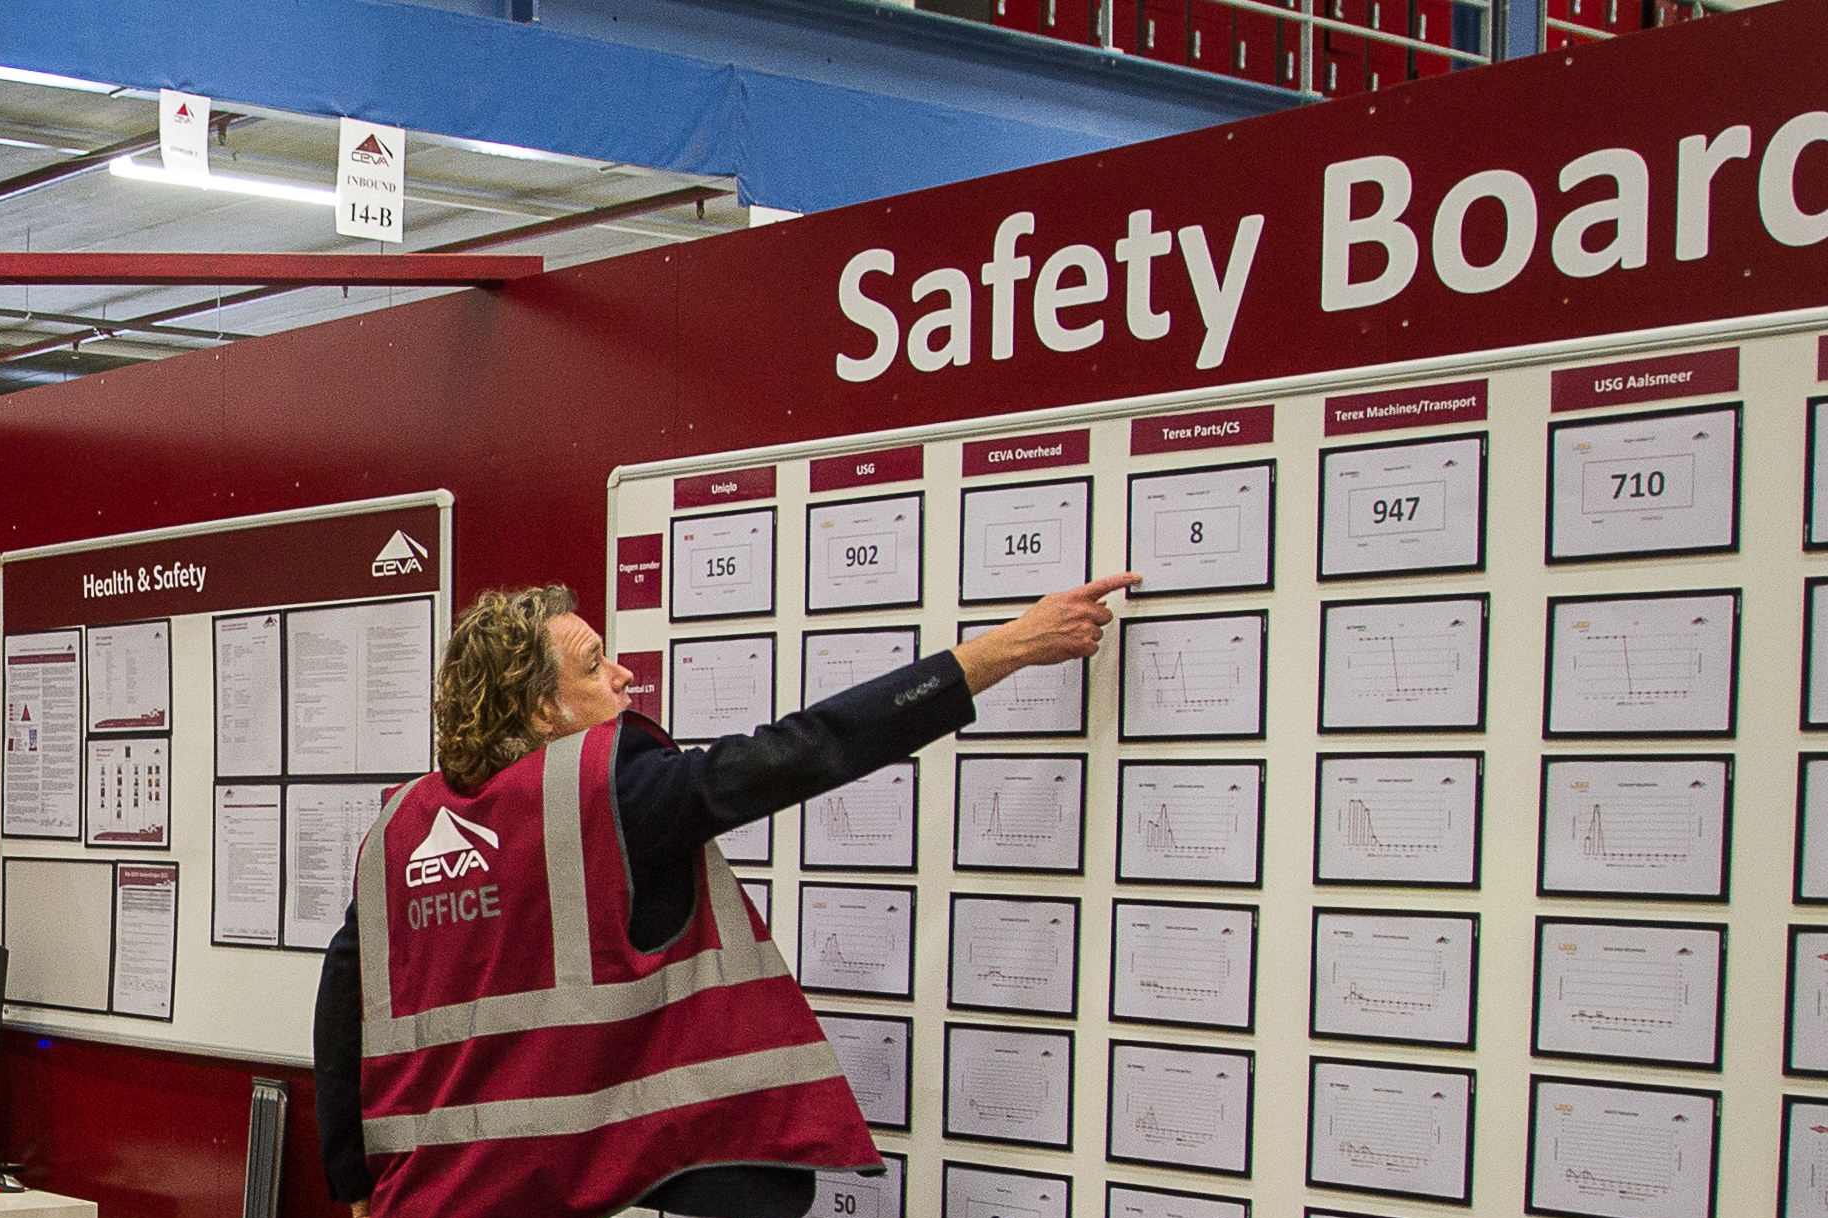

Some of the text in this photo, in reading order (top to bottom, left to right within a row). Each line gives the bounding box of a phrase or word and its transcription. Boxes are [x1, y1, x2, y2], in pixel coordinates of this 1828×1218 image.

[346, 174, 397, 193] INBOUND
[350, 202, 393, 228] 14-B
[835, 208, 1265, 383] Safety
[1594, 370, 1694, 393] USG Aalsmeer
[1335, 395, 1477, 422] Terex Machines/Transport
[1163, 420, 1241, 440] Terex Parts/CS
[988, 443, 1063, 463] CEVA Overhead
[856, 463, 876, 476] USG
[711, 481, 738, 495] Uniqlo
[1611, 470, 1667, 500] 710
[1372, 496, 1421, 524] 947
[1004, 532, 1042, 556] 146
[1190, 521, 1203, 544] 8
[706, 556, 737, 578] 156
[845, 545, 879, 567] 902
[83, 561, 207, 599] Health & Safety
[406, 849, 490, 888] CEVA
[408, 884, 502, 931] OFFICE
[834, 1192, 856, 1215] 50
